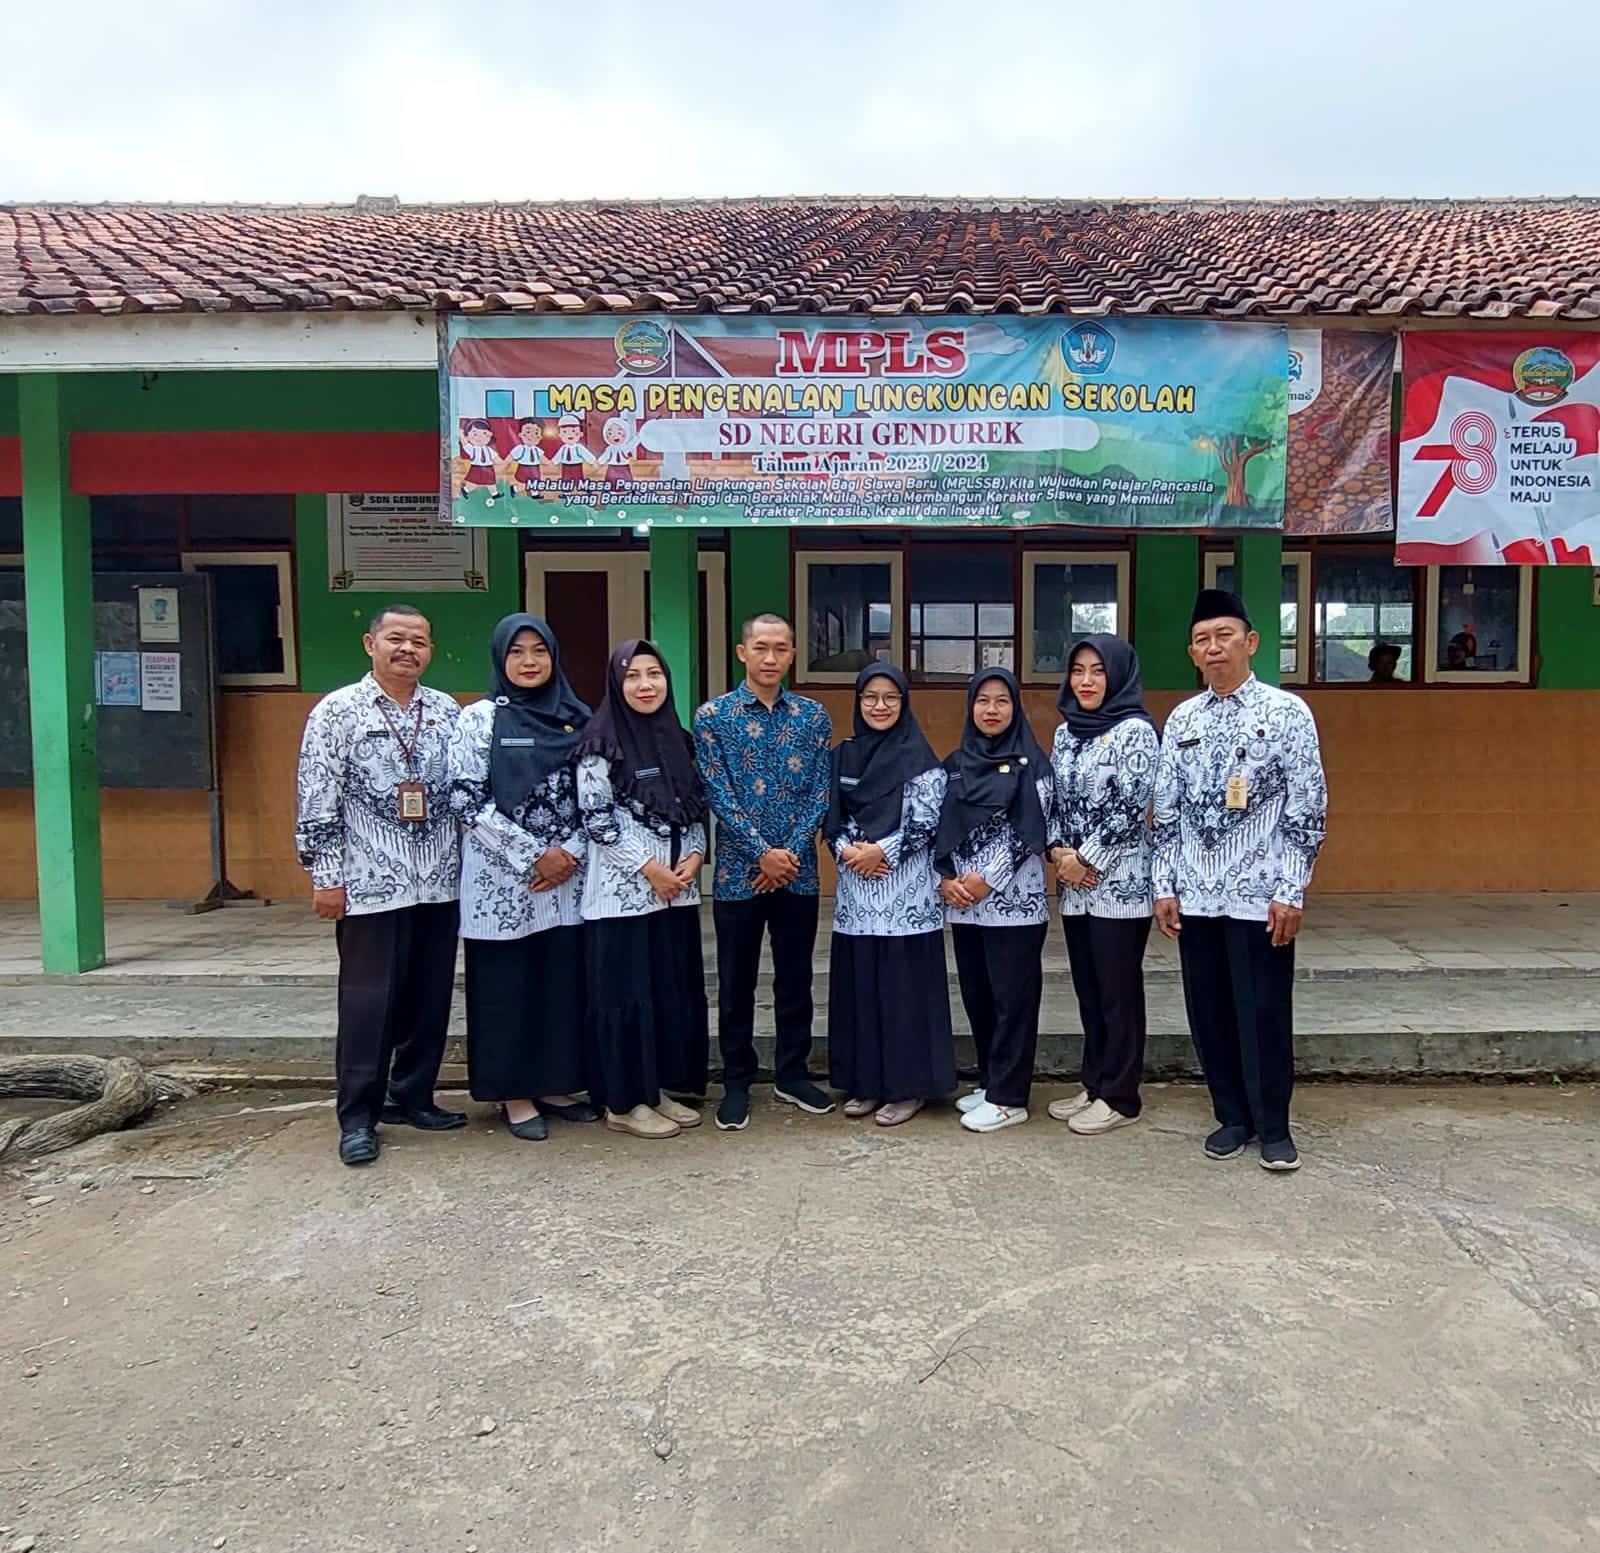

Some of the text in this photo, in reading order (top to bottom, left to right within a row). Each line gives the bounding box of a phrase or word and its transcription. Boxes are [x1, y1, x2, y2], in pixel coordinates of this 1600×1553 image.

[777, 330, 967, 375] MPLS
[548, 383, 1196, 412] MASA PENGENALAN LINGKUNGAN SEKOLAH
[719, 421, 1024, 445] SD NEGERI GENDUREK
[1511, 426, 1561, 438] TERUS
[1510, 442, 1573, 454] MELAJU
[753, 456, 811, 472] Tahun
[818, 456, 881, 475] Ajaran
[885, 456, 929, 472] 2023
[944, 455, 988, 471] 2024
[1511, 459, 1562, 471] UNTUK
[526, 479, 574, 491] Melalui
[577, 479, 611, 491] Masa
[615, 479, 691, 494] Pengenalan
[695, 479, 772, 494] Lingkungan
[774, 478, 828, 491] Sekolah
[831, 478, 859, 492] Bagi
[864, 477, 901, 490] Siswa
[906, 477, 938, 489] Baru
[1038, 475, 1098, 490] Wujudkan
[1102, 479, 1147, 493] Pelajar
[1151, 480, 1215, 493] Pancasila
[1510, 475, 1591, 487] INDONESIA
[565, 487, 1176, 507] yang Berdedikasi Tinggi dan Berakhlak Mulia, Serta Membangun Karakter Siswa yang Memiliki
[1510, 491, 1552, 503] MAJU
[743, 503, 1001, 519] Karakter Pancasila, Kreatif dan Inovatif.
